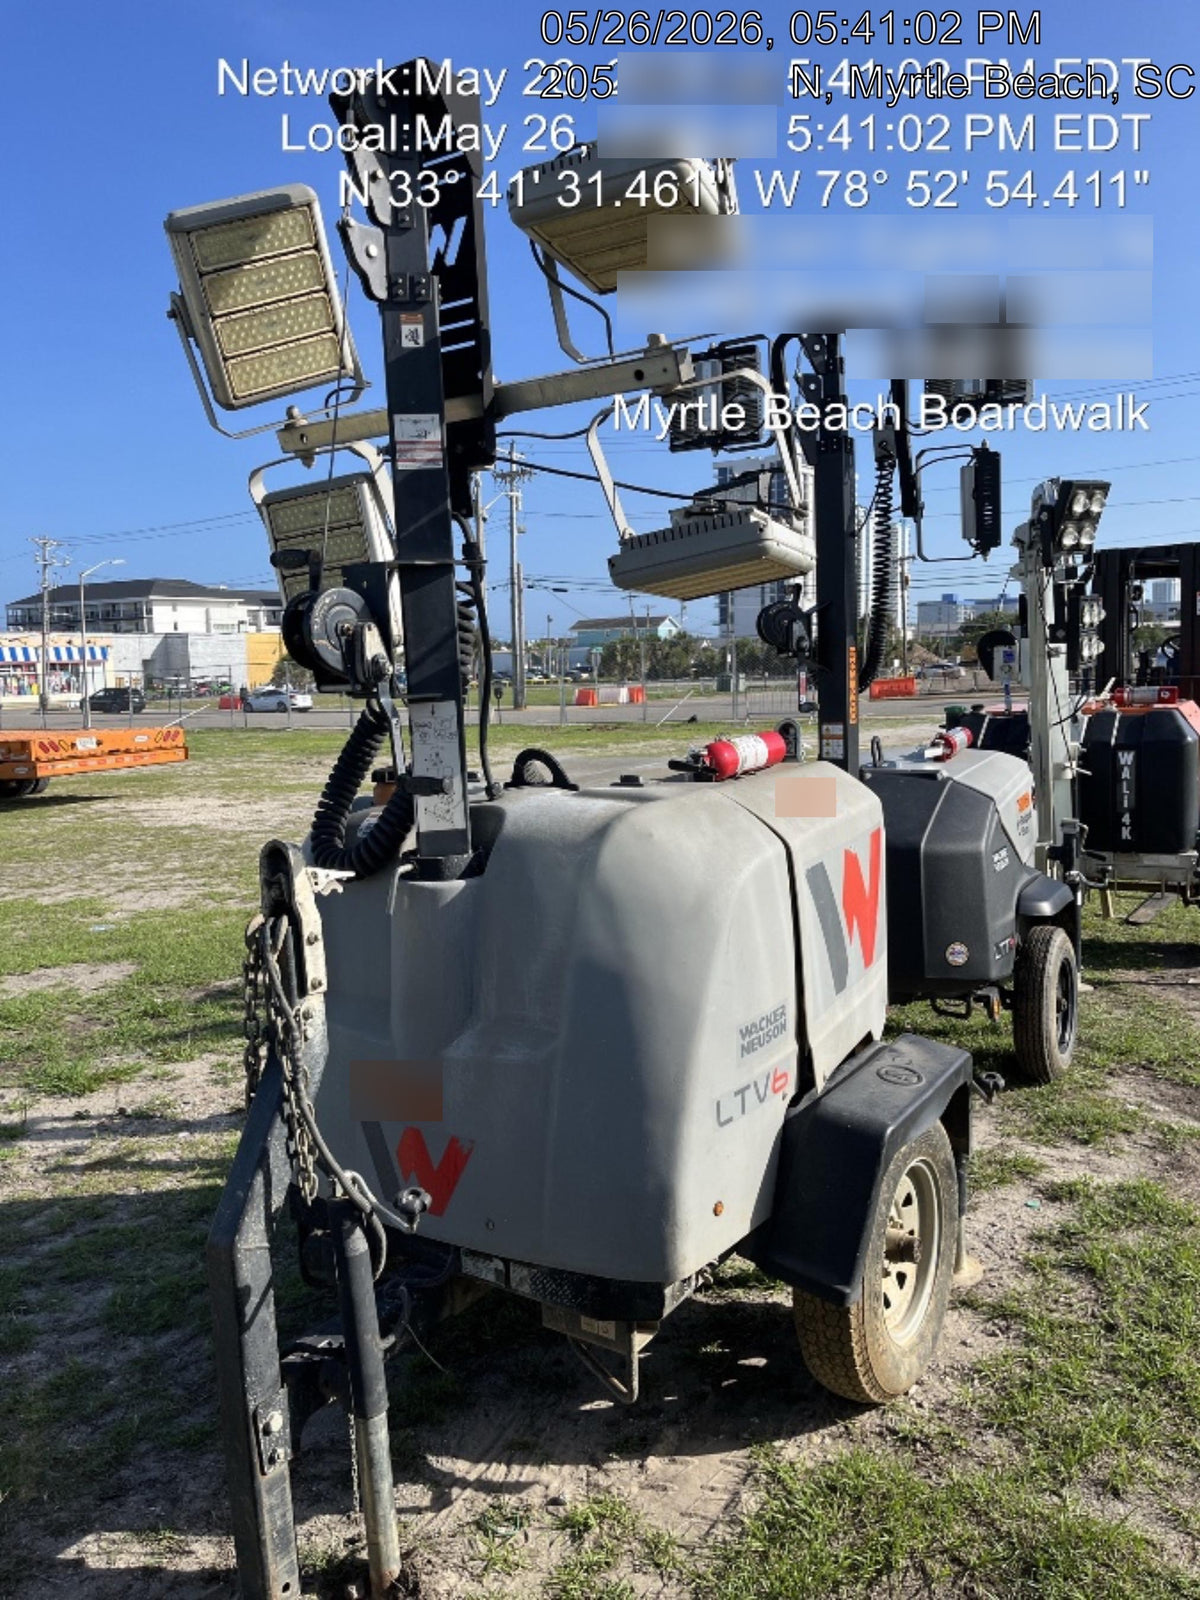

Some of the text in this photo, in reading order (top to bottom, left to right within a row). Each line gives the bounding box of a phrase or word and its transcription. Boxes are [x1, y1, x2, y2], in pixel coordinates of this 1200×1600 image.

[739, 1004, 786, 1041] WACKER
[740, 1019, 787, 1058] NEUSON
[715, 1067, 789, 1127] LTV6
